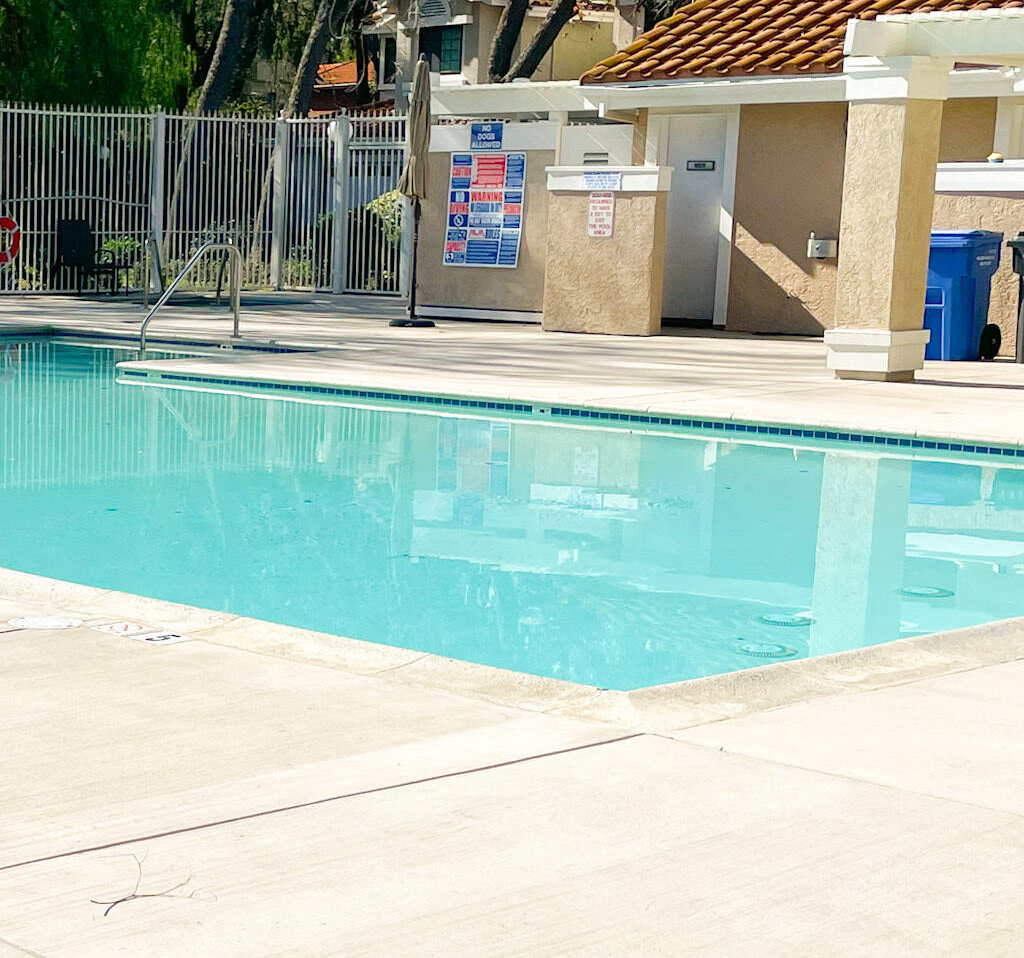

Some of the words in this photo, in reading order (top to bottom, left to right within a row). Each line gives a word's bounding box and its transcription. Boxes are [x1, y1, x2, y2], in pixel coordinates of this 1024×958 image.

[471, 141, 501, 149] ALLOWED
[471, 191, 503, 202] WARNING
[144, 634, 182, 642] 5
